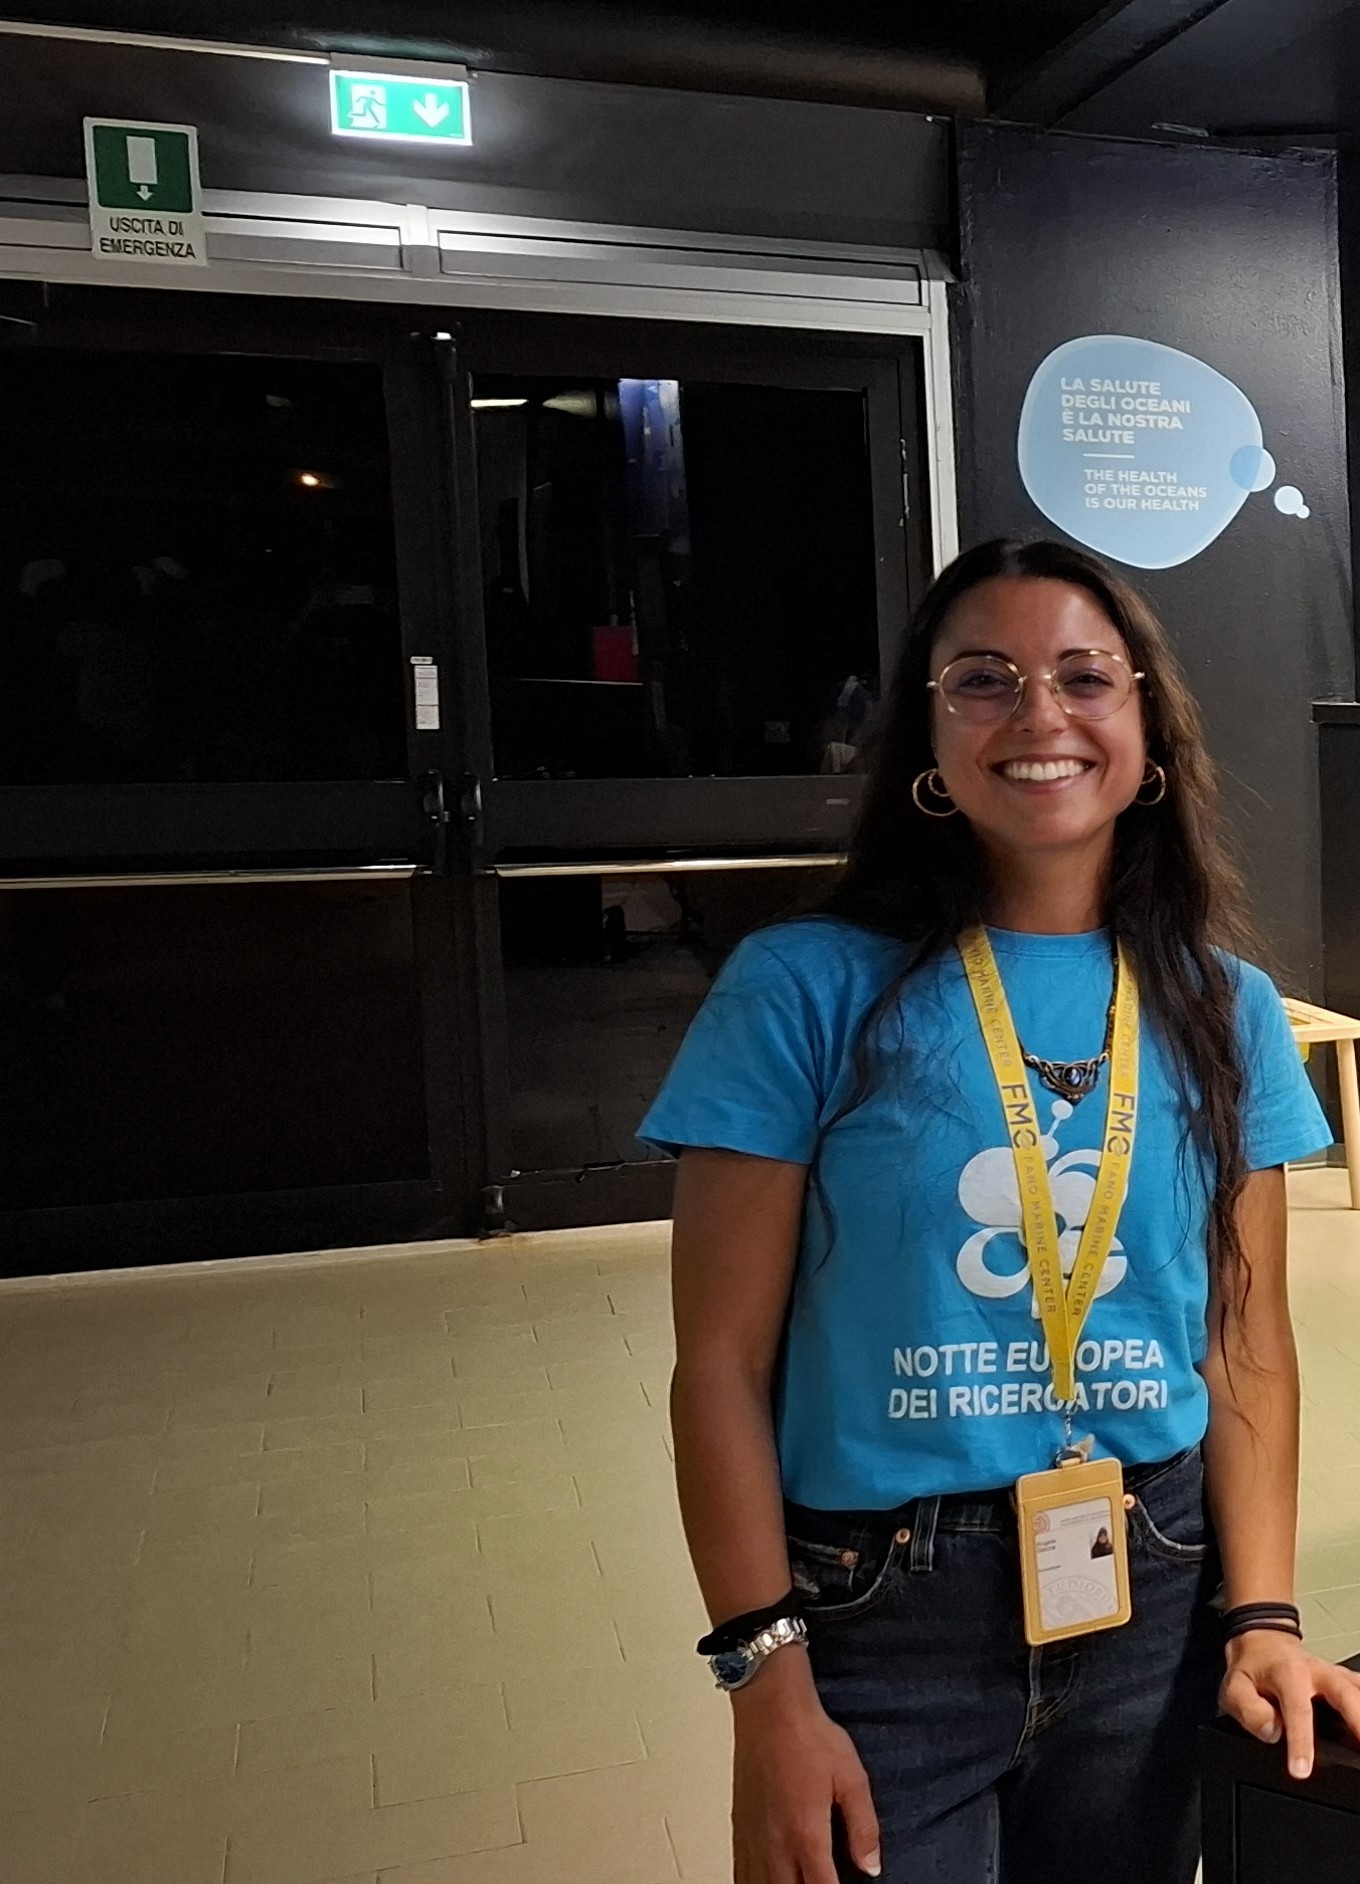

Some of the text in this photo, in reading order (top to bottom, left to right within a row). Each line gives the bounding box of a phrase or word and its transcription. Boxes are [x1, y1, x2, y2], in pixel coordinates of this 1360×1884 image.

[110, 216, 183, 236] USCITA DI
[100, 238, 196, 258] EMERGENZA
[1061, 377, 1161, 395] LA SALUTE
[1061, 395, 1191, 413] DEGLI OCEANI
[1063, 408, 1184, 429] È LA NOSTRA
[1063, 428, 1135, 444] SALUTE
[1085, 469, 1177, 483] THE HEALTH
[1084, 483, 1207, 497] OF THE OCEANS
[1085, 498, 1199, 511] IS OUR HEALTH
[1002, 1083, 1057, 1314] FMC FANO MARINE CENTER
[1071, 1092, 1135, 1317] FMC FANO MARINE CENTER
[893, 1339, 1164, 1377] NOTTE EUOPEA
[888, 1387, 937, 1420] DEI
